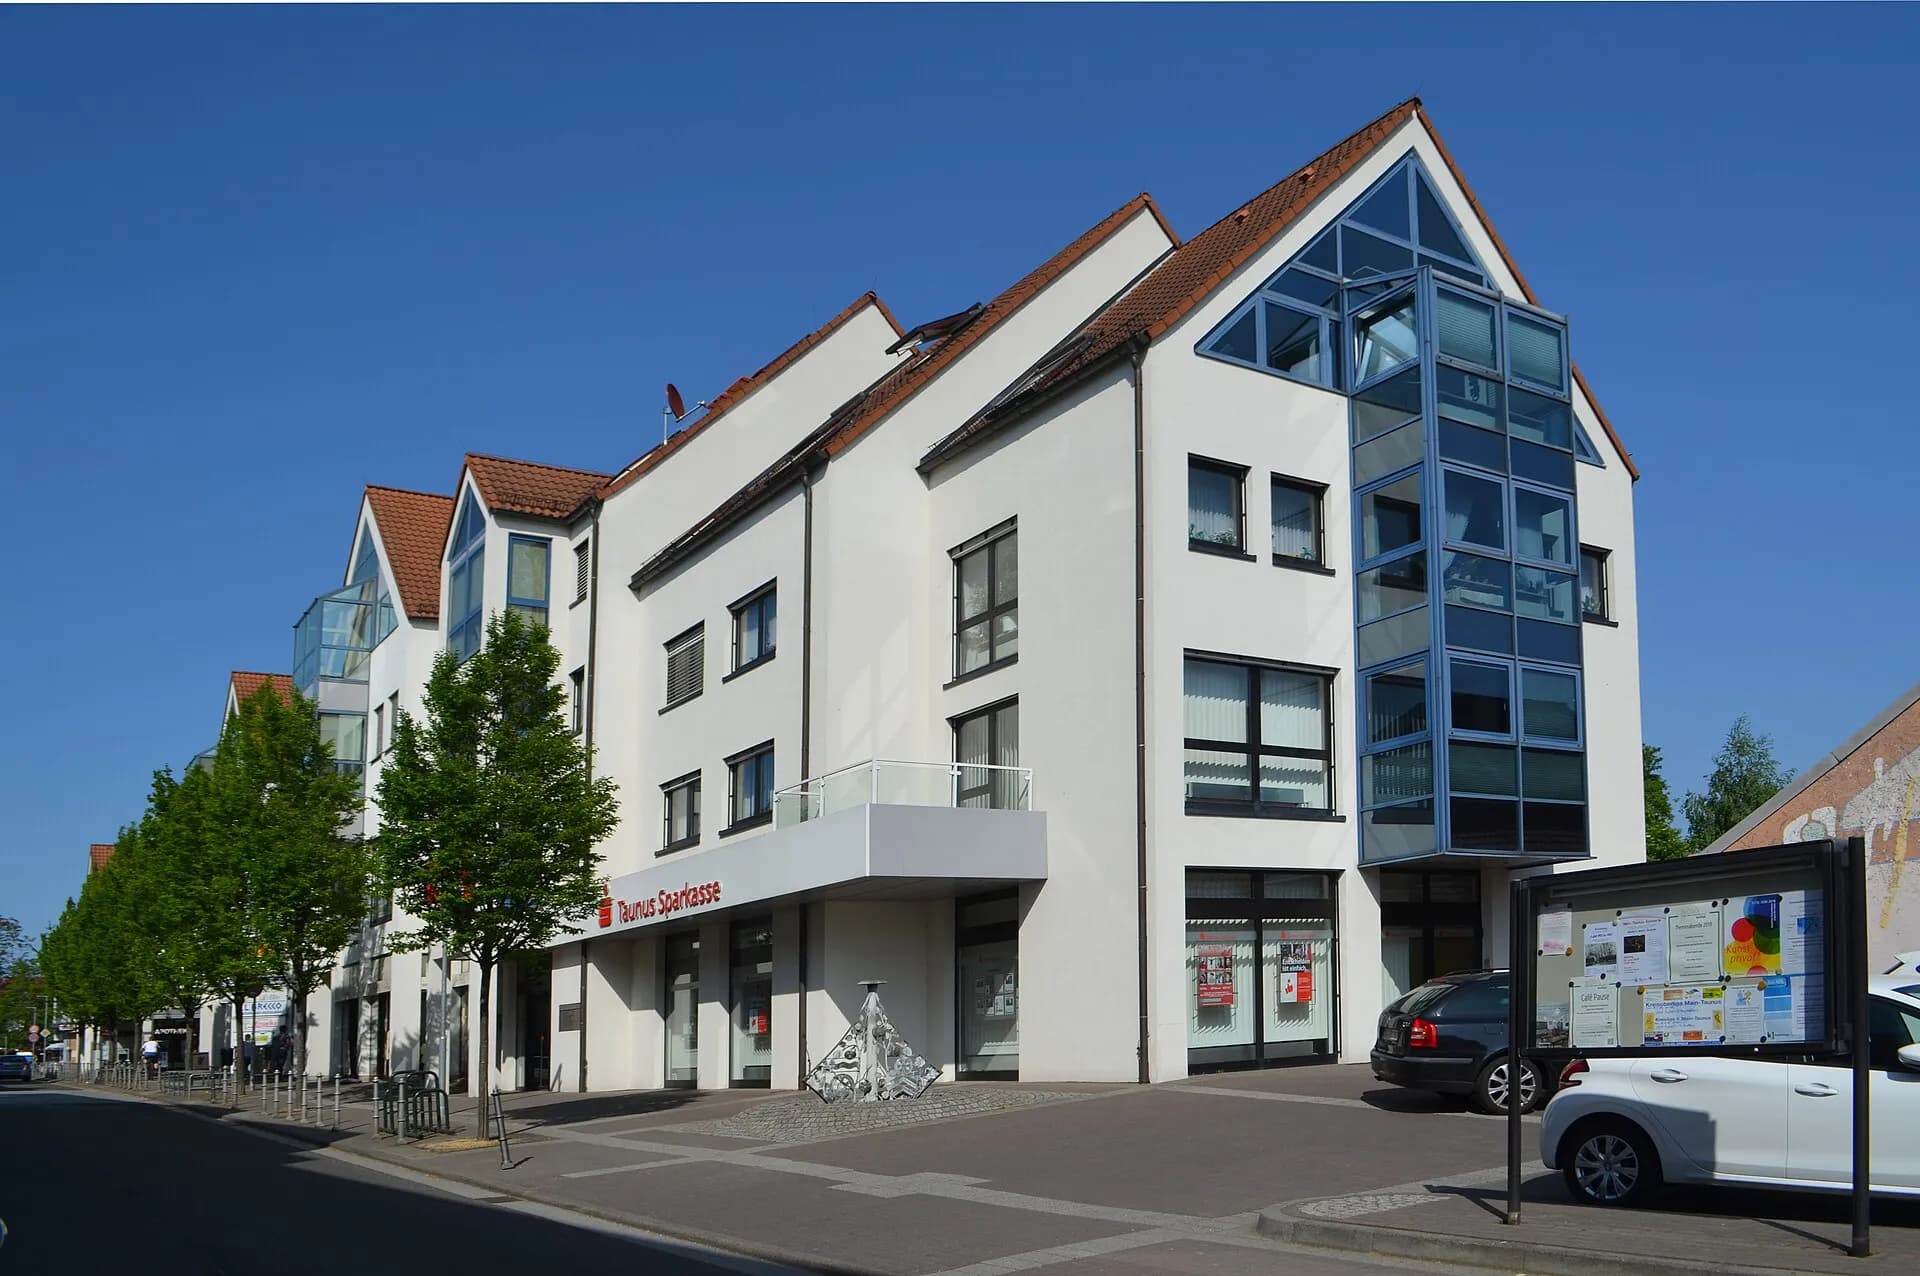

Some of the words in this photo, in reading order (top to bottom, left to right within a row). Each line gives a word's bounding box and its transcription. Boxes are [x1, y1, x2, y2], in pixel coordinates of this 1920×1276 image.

[617, 898, 656, 924] Taunus
[658, 881, 721, 919] Sparkasse
[1726, 944, 1750, 953] Kunst
